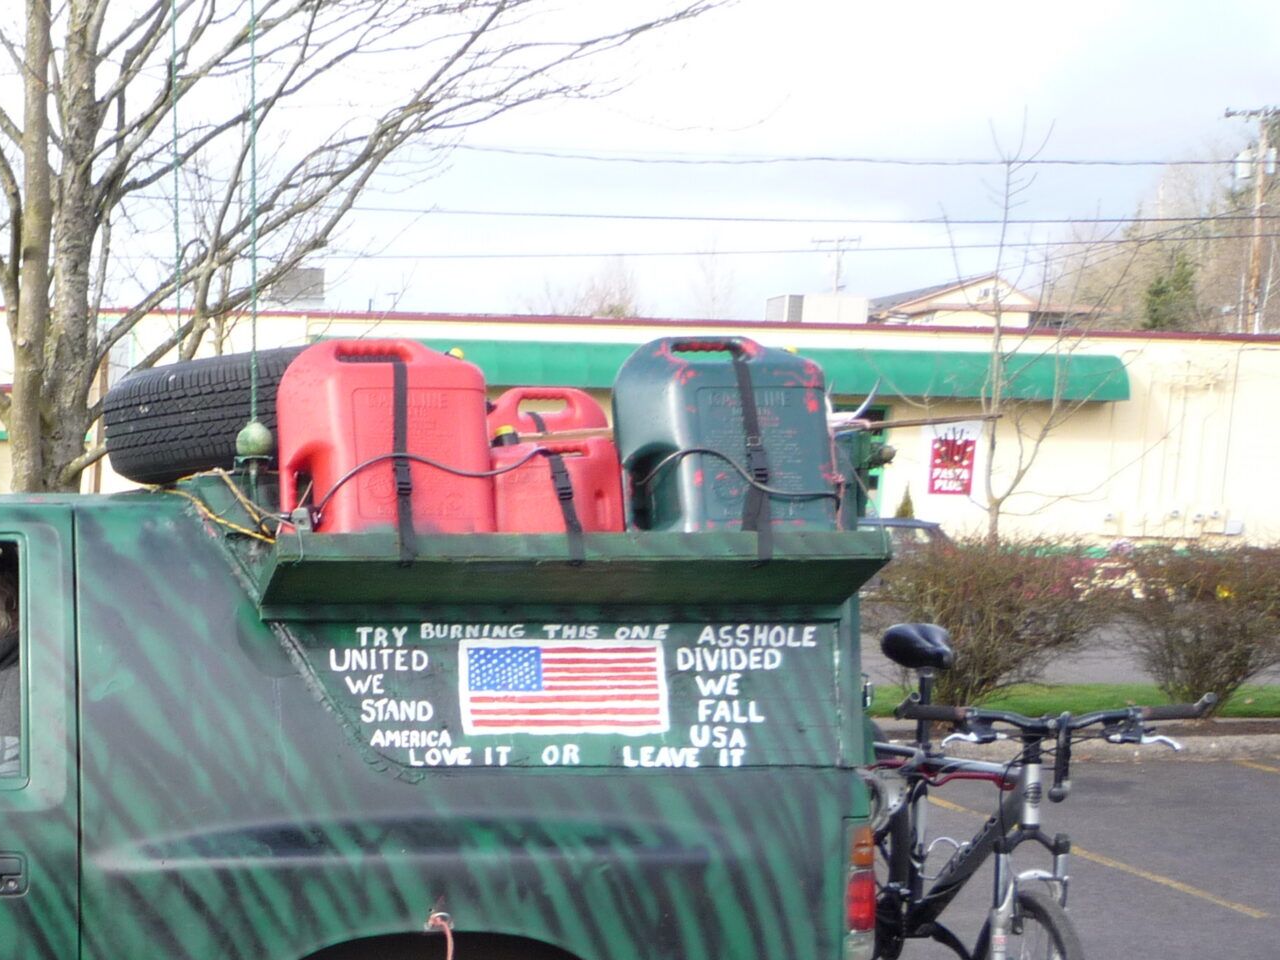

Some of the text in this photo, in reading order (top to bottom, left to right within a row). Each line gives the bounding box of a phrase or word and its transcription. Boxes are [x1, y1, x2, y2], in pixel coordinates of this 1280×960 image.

[356, 623, 817, 647] TRY BURNING THIS ONE ASSHOLE
[329, 648, 429, 672] UNITED
[676, 648, 782, 672] DIVIDED
[344, 673, 385, 694] WE
[694, 673, 742, 696] WE
[360, 698, 433, 723] STAND
[697, 699, 765, 723] FALL
[370, 729, 452, 748] AMERICA
[689, 725, 746, 748] USA
[409, 744, 745, 767] LOVE IT OR LEAVE IT
